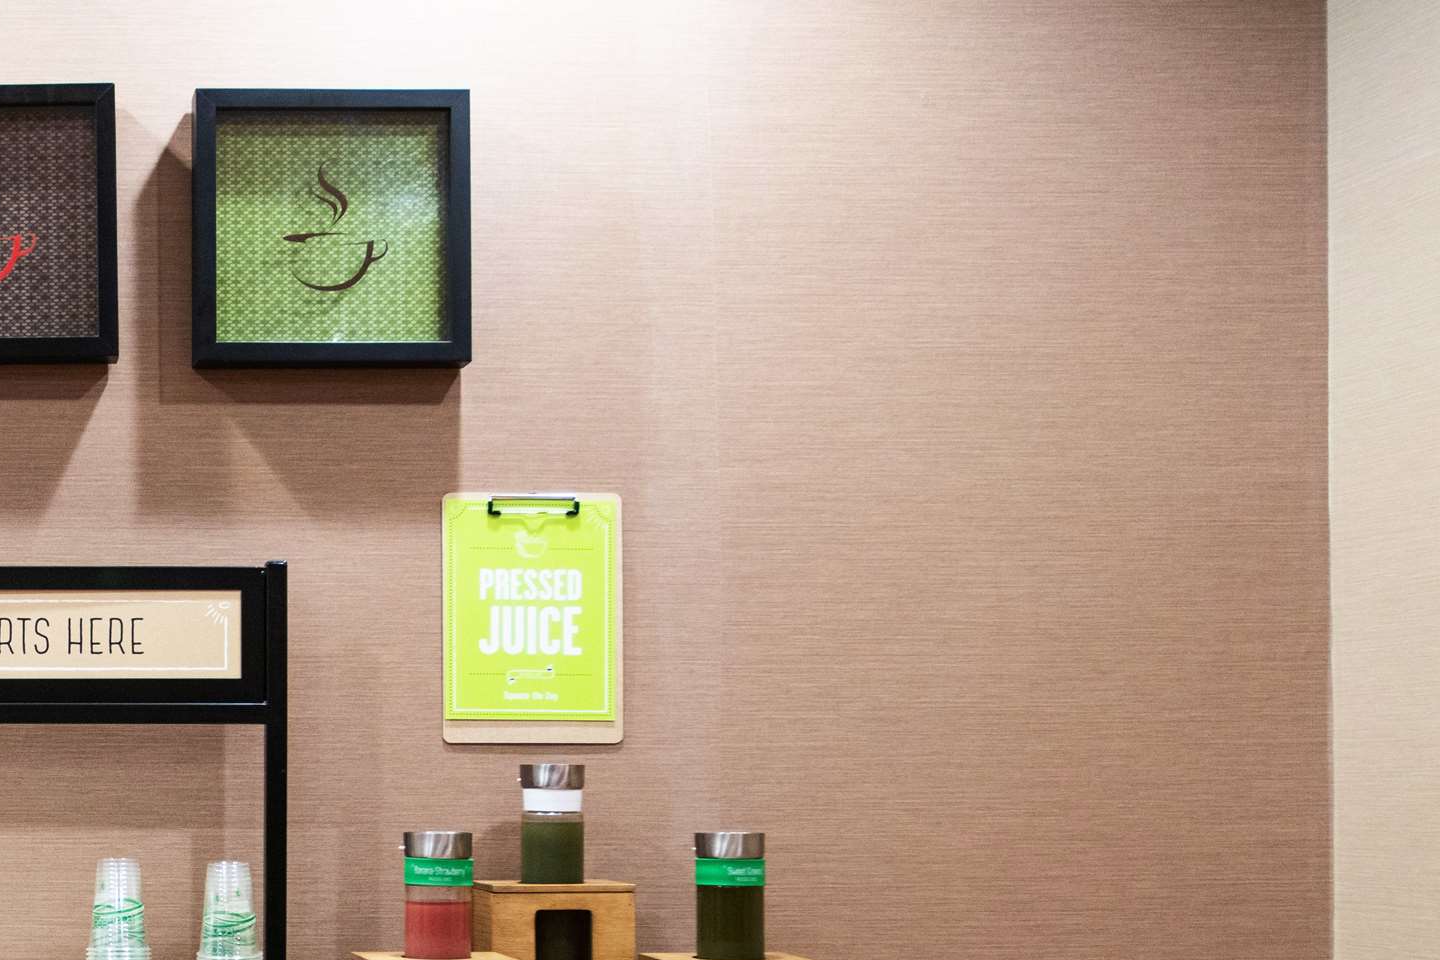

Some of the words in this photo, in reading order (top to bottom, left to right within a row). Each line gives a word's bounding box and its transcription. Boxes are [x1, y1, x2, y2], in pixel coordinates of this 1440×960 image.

[479, 568, 582, 600] PRESSED
[66, 617, 145, 655] HERE
[479, 605, 582, 656] JUICE
